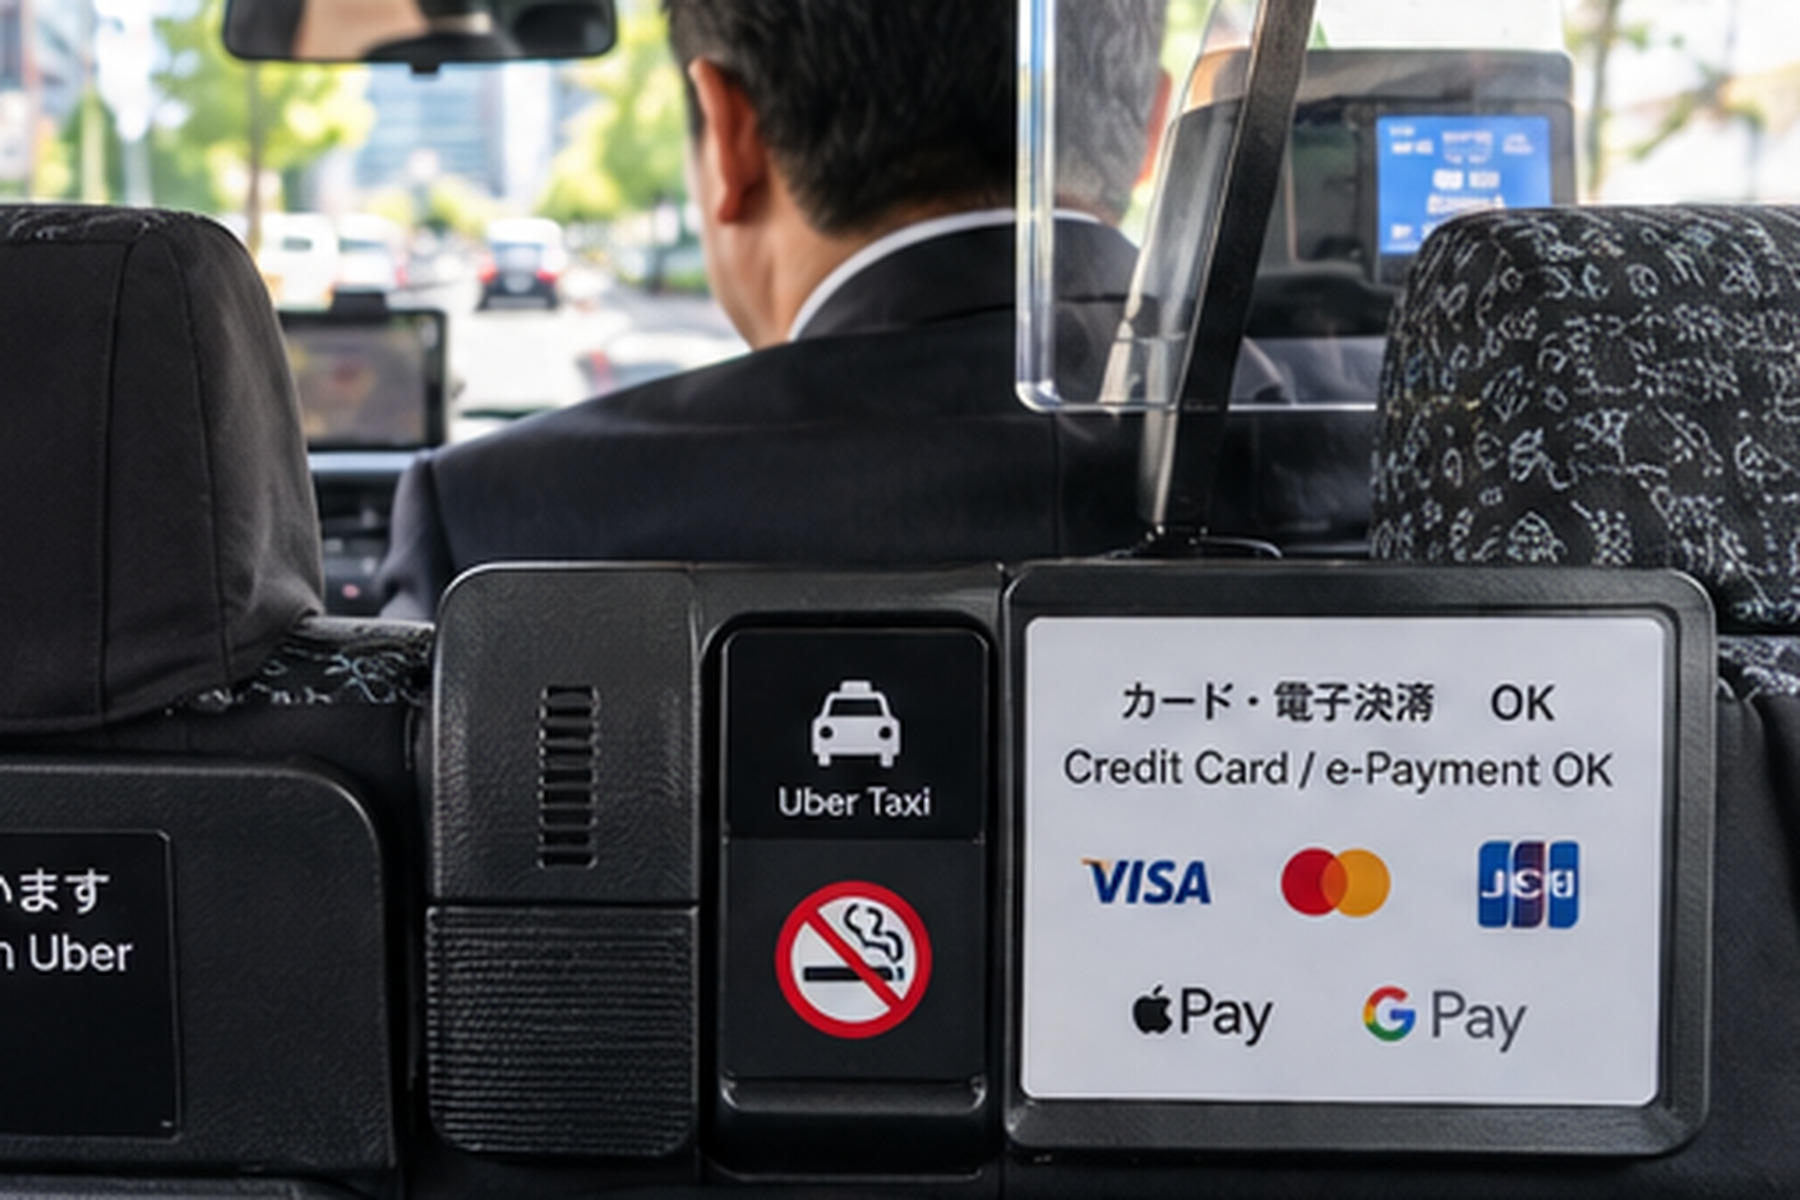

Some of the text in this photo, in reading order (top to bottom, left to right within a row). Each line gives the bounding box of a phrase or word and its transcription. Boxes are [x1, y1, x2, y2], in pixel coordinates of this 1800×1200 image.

[1122, 681, 1555, 722] カード・電子決済 OK
[1064, 749, 1613, 794] Credit Card / e-Payment OK
[778, 787, 931, 817] Uber Taxi
[1082, 858, 1212, 905] VISA
[29, 933, 134, 972] Uber
[1180, 986, 1274, 1047] Pay
[1432, 991, 1527, 1053] Pay
